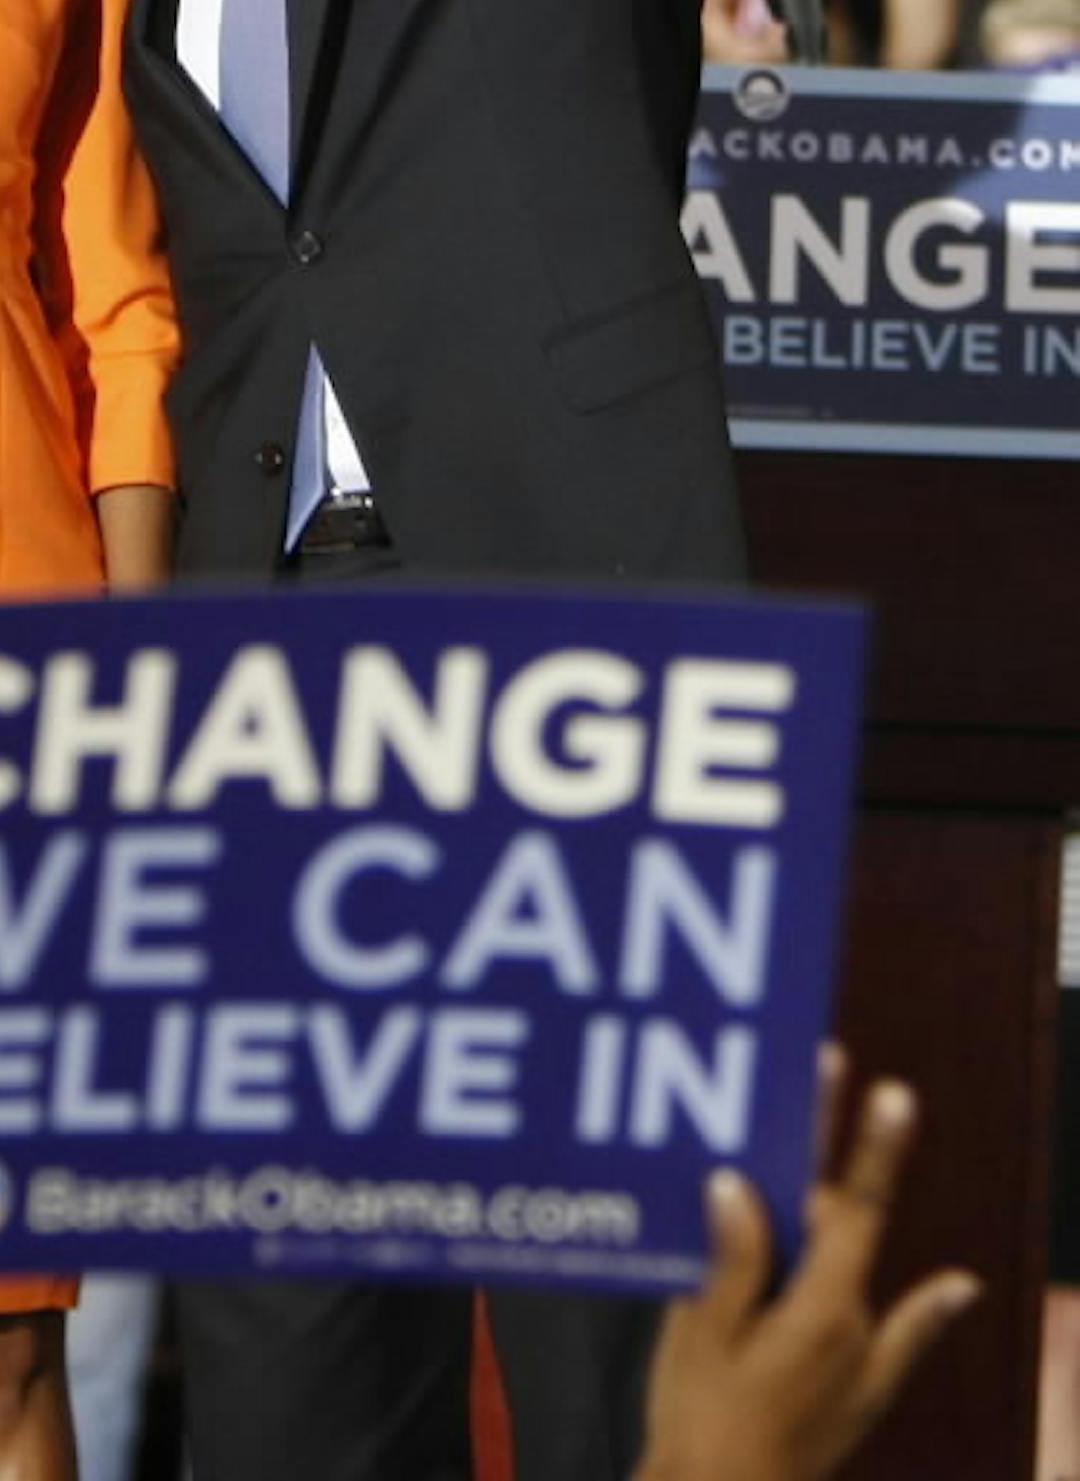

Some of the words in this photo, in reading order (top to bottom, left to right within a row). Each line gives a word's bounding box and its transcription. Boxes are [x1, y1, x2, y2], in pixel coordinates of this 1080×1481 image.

[723, 315, 1000, 373] BELIEVE
[1023, 324, 1080, 376] IN
[292, 823, 780, 1010] CAN
[574, 1012, 758, 1156] IN
[24, 1166, 642, 1246] BarackObama.com
